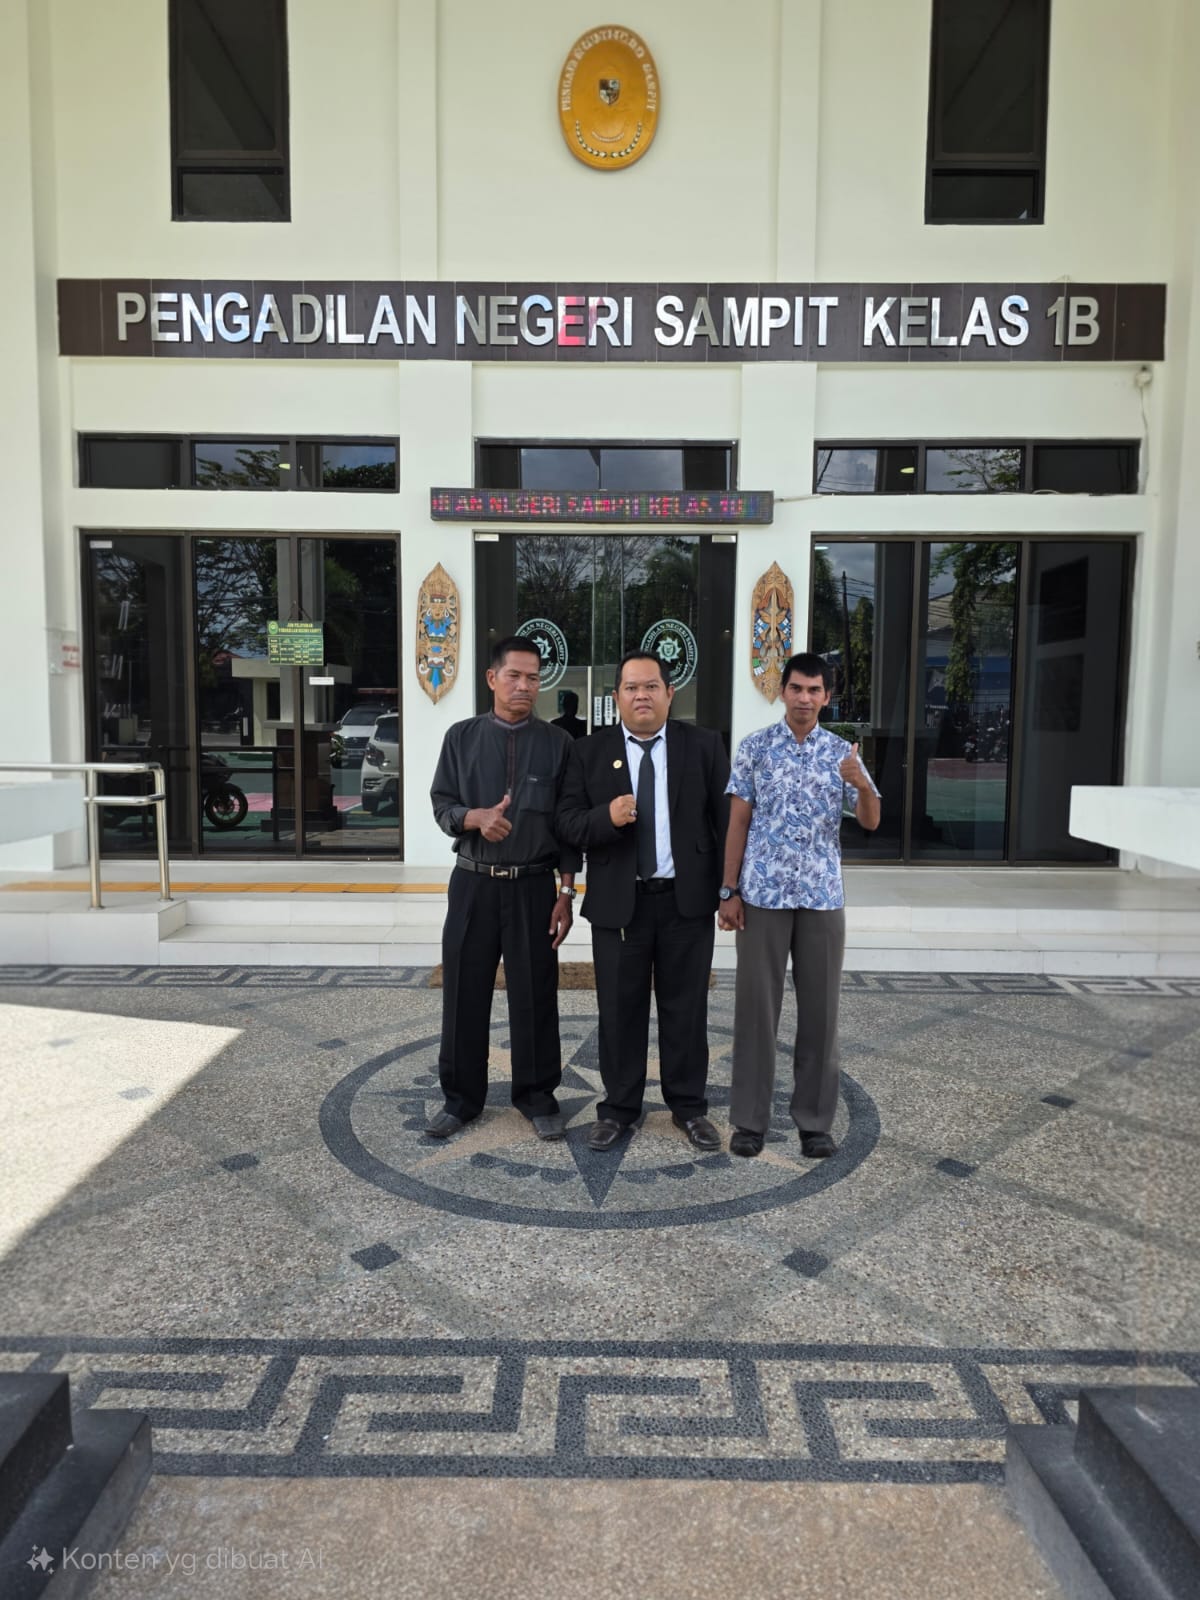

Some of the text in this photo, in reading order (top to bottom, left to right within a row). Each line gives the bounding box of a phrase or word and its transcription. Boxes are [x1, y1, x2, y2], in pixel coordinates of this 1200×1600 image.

[116, 292, 1100, 347] PENGADILAN NEGERI SAMPIT KELAS 1B
